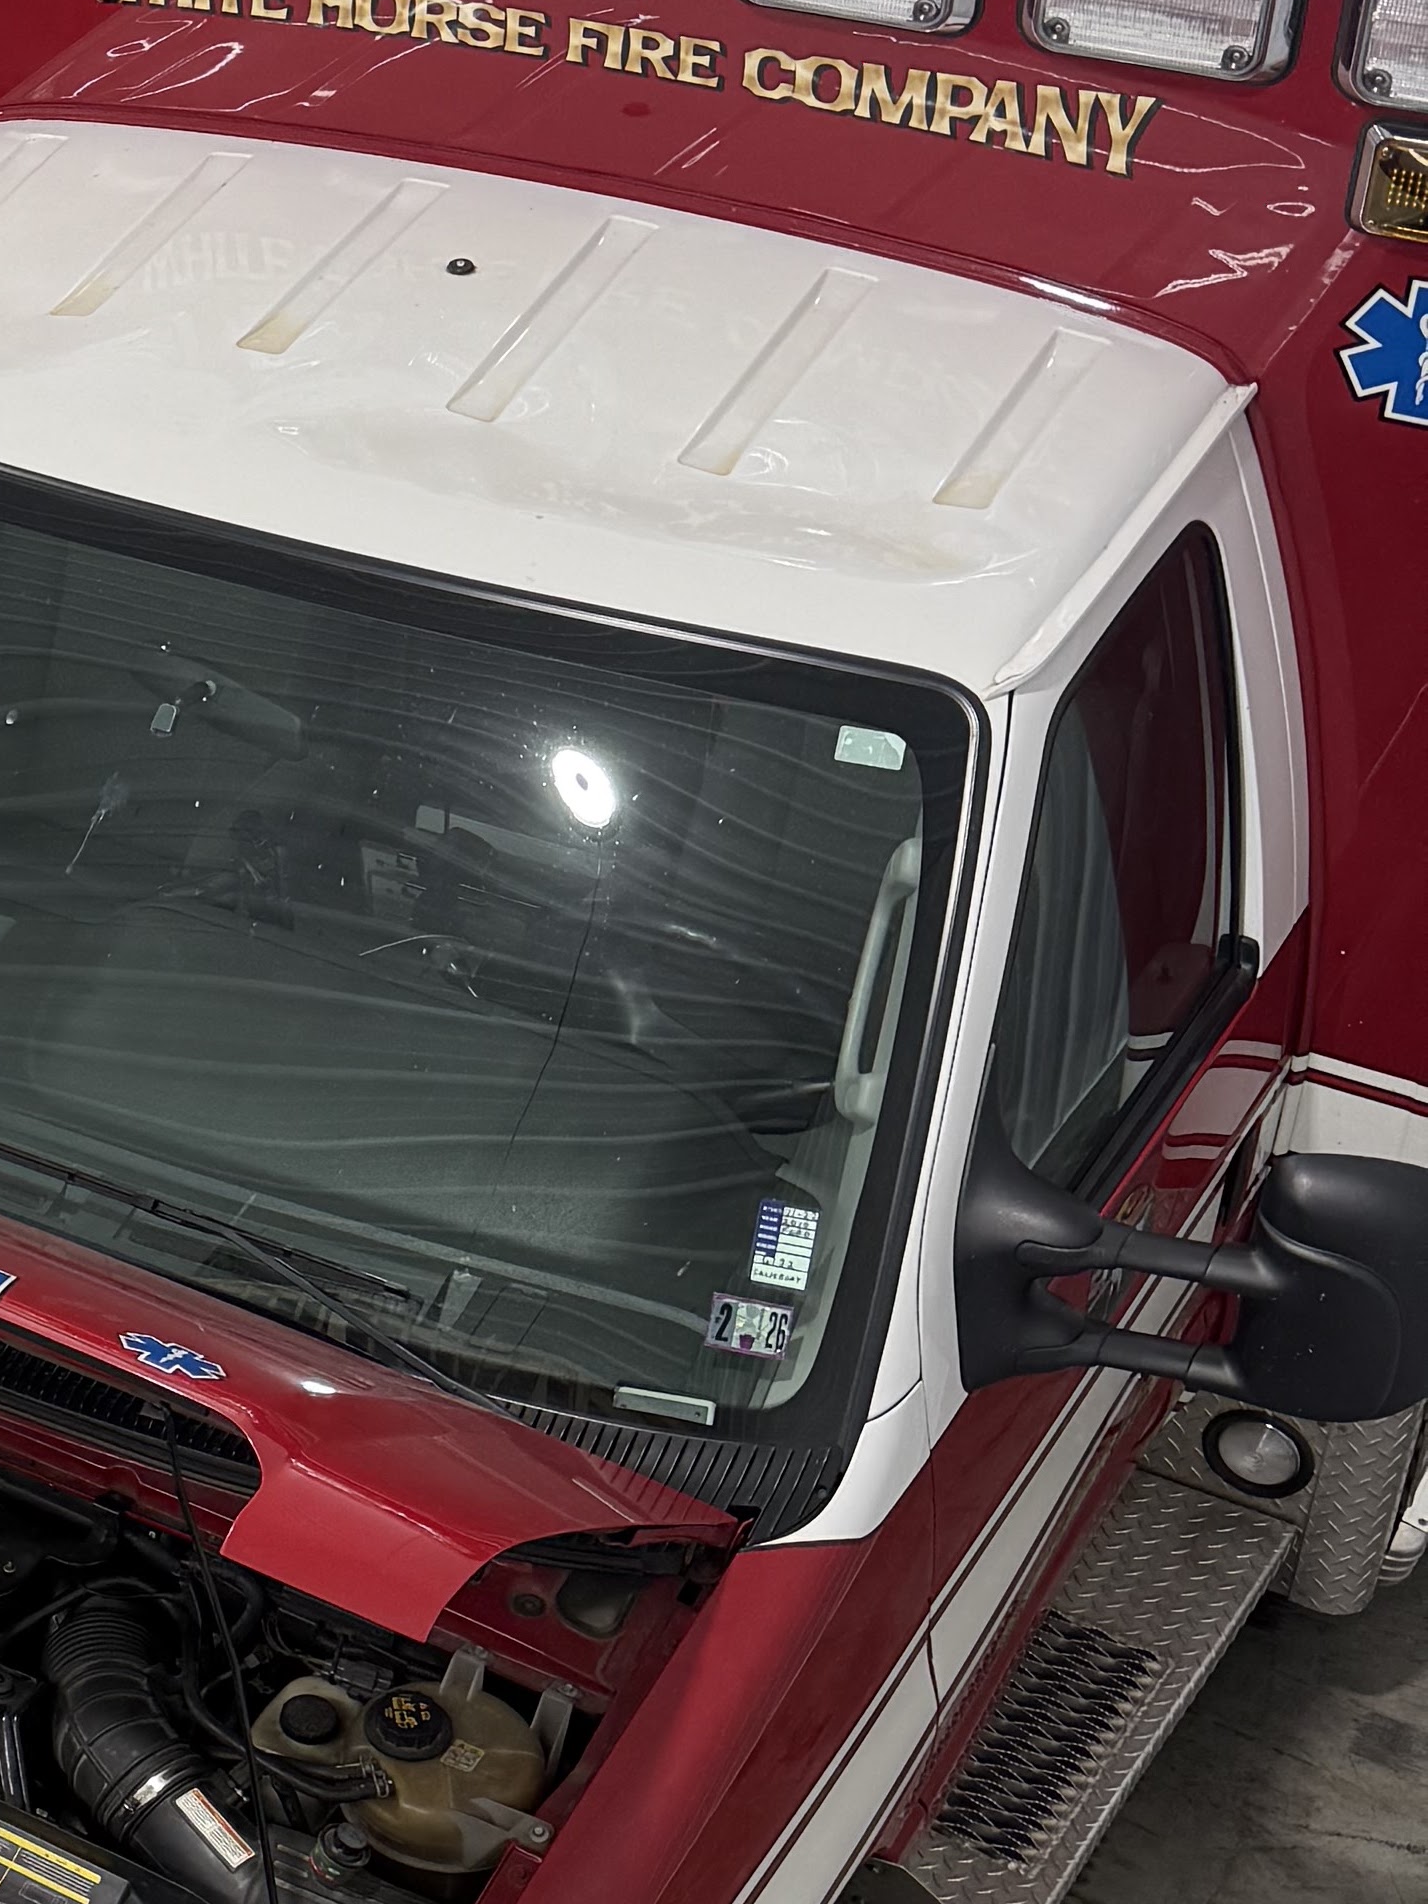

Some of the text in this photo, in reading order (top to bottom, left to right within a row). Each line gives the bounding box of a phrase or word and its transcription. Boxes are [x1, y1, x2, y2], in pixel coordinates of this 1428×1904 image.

[563, 21, 726, 91] FIRE
[742, 46, 1161, 179] COMPANY
[715, 1302, 789, 1353] 2 26
